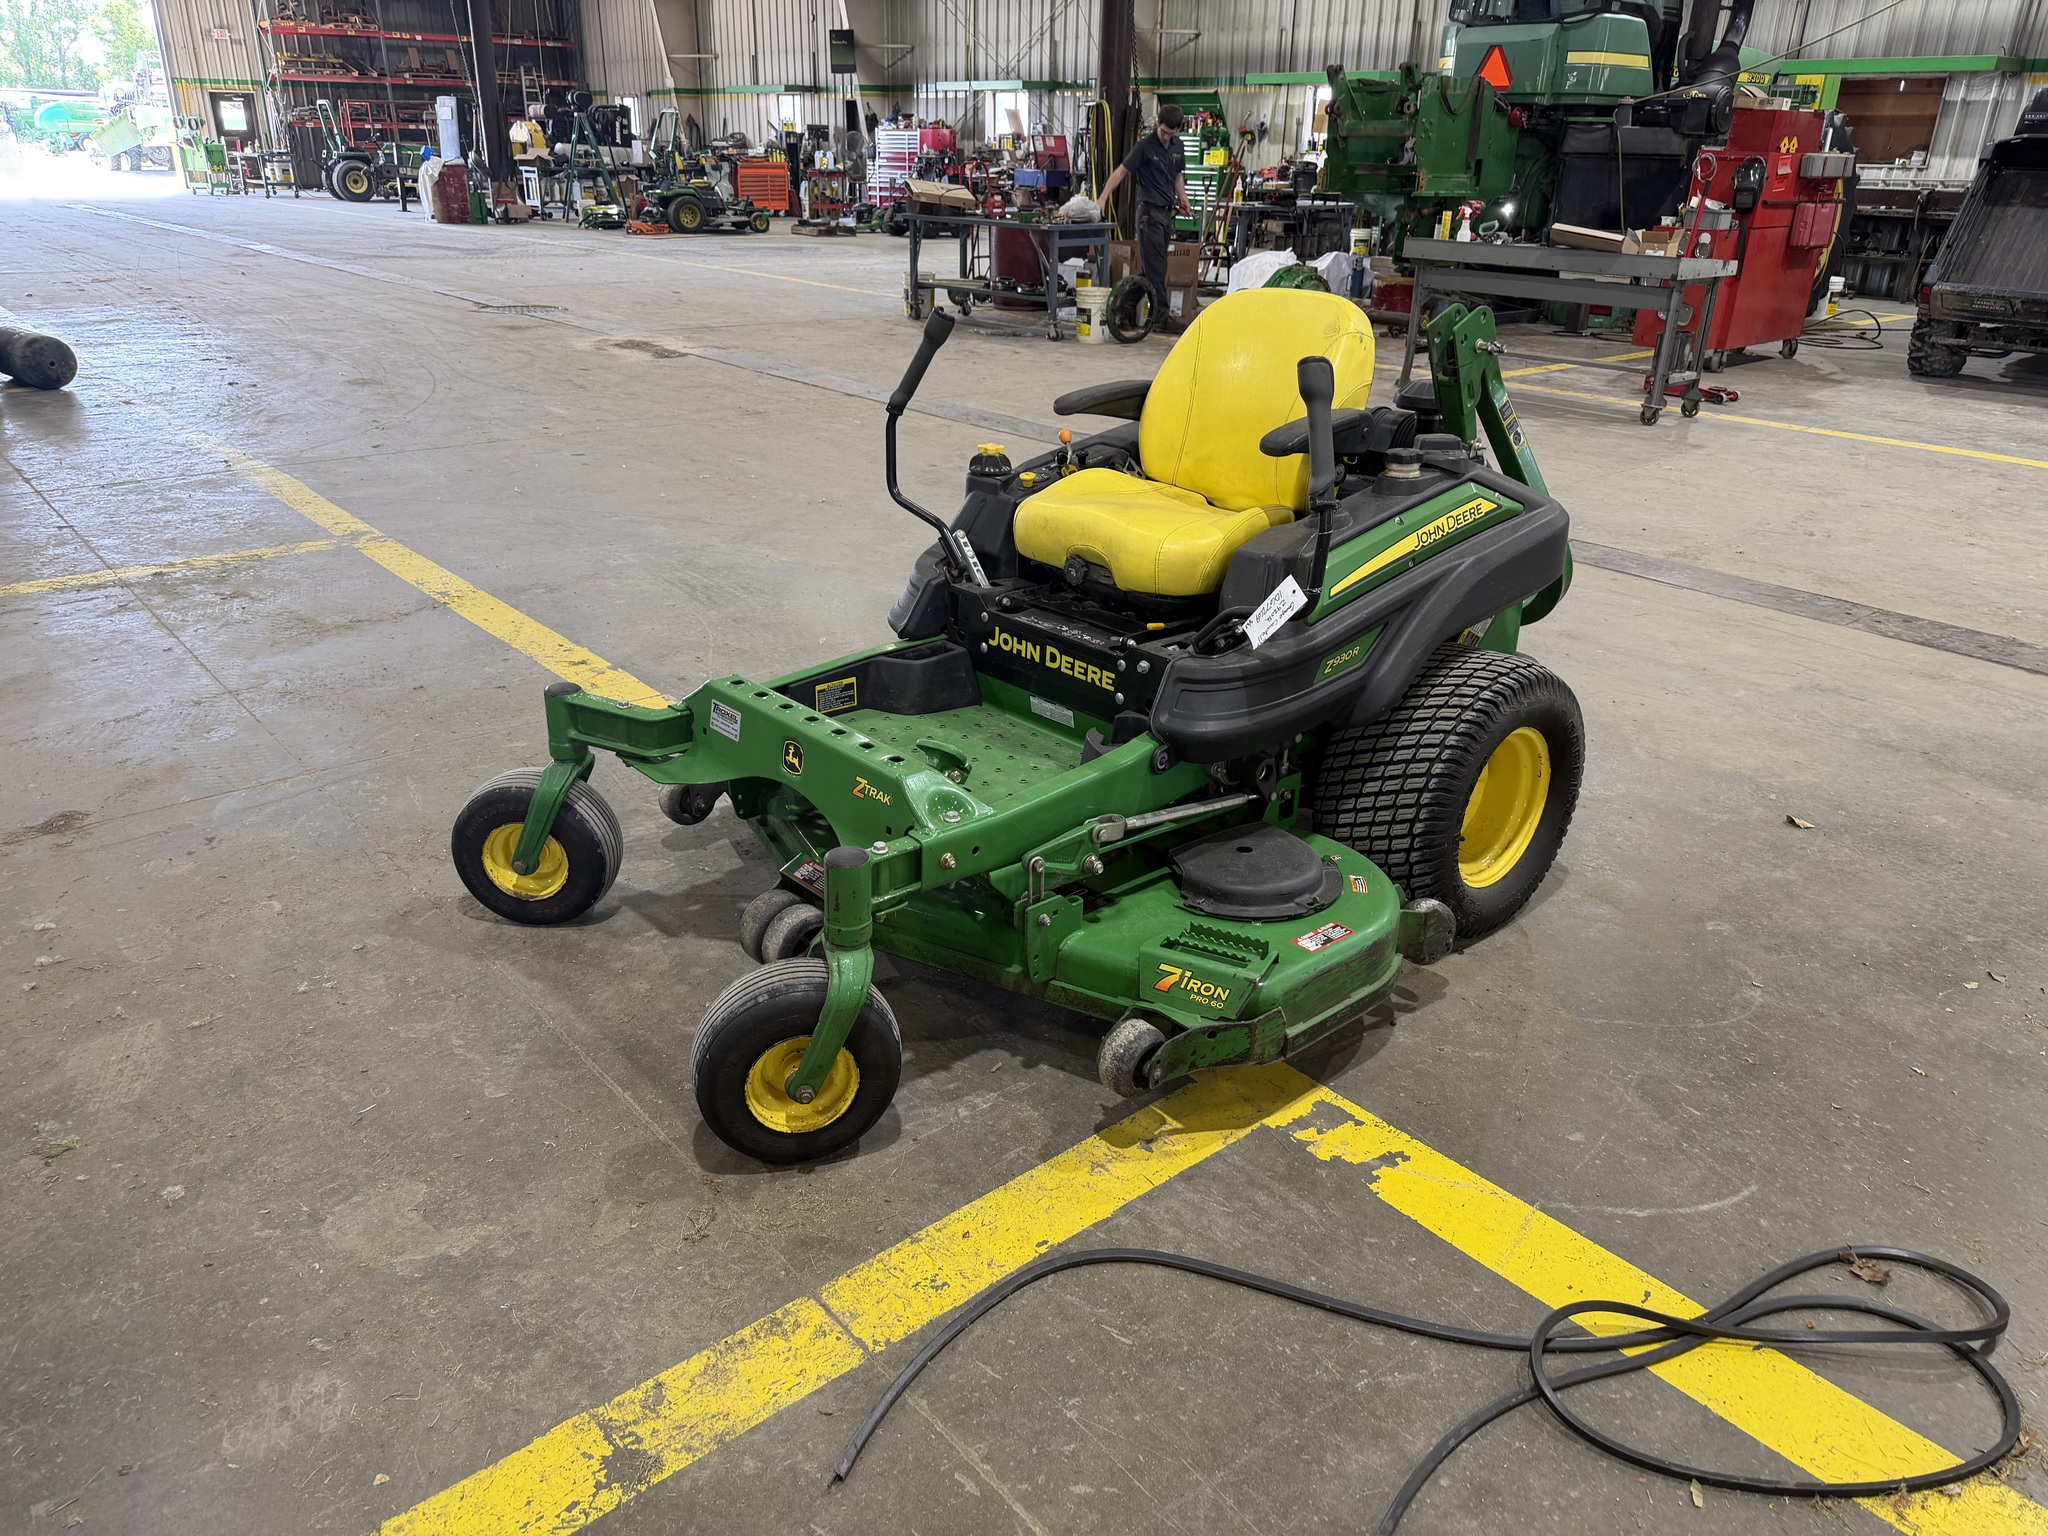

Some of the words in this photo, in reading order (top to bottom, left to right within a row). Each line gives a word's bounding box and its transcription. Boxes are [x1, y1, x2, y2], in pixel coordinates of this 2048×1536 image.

[1414, 522, 1445, 549] JOHN
[1446, 502, 1484, 531] DEERE
[988, 626, 1041, 664] JOHN
[1045, 644, 1116, 692] DEERE
[1323, 645, 1361, 675] Z930R
[1189, 993, 1209, 1005] PRO
[1210, 1000, 1224, 1009] 60
